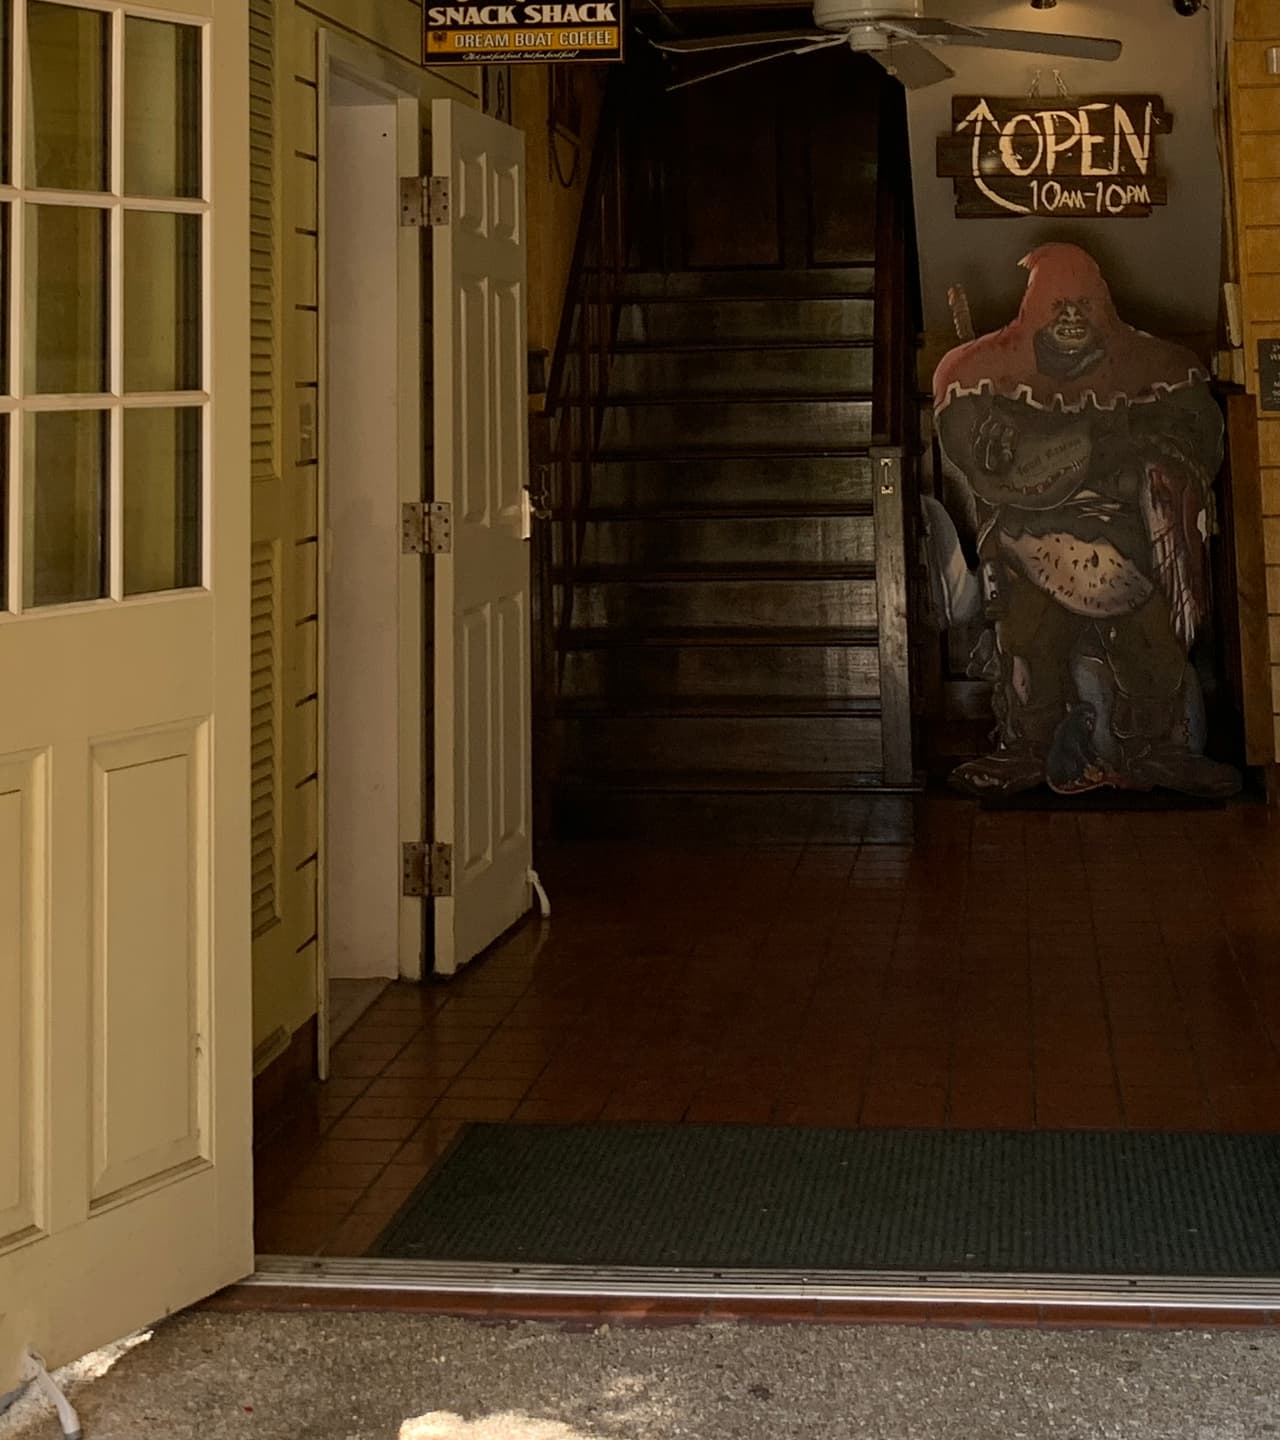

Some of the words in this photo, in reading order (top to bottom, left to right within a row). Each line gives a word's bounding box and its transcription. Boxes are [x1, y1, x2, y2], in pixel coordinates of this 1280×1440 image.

[428, 5, 518, 27] SNACK
[524, 2, 616, 24] SHACK
[455, 30, 509, 48] DREAM
[514, 31, 553, 47] BOAT
[559, 30, 612, 46] COFFEE
[999, 102, 1153, 176] OPEN
